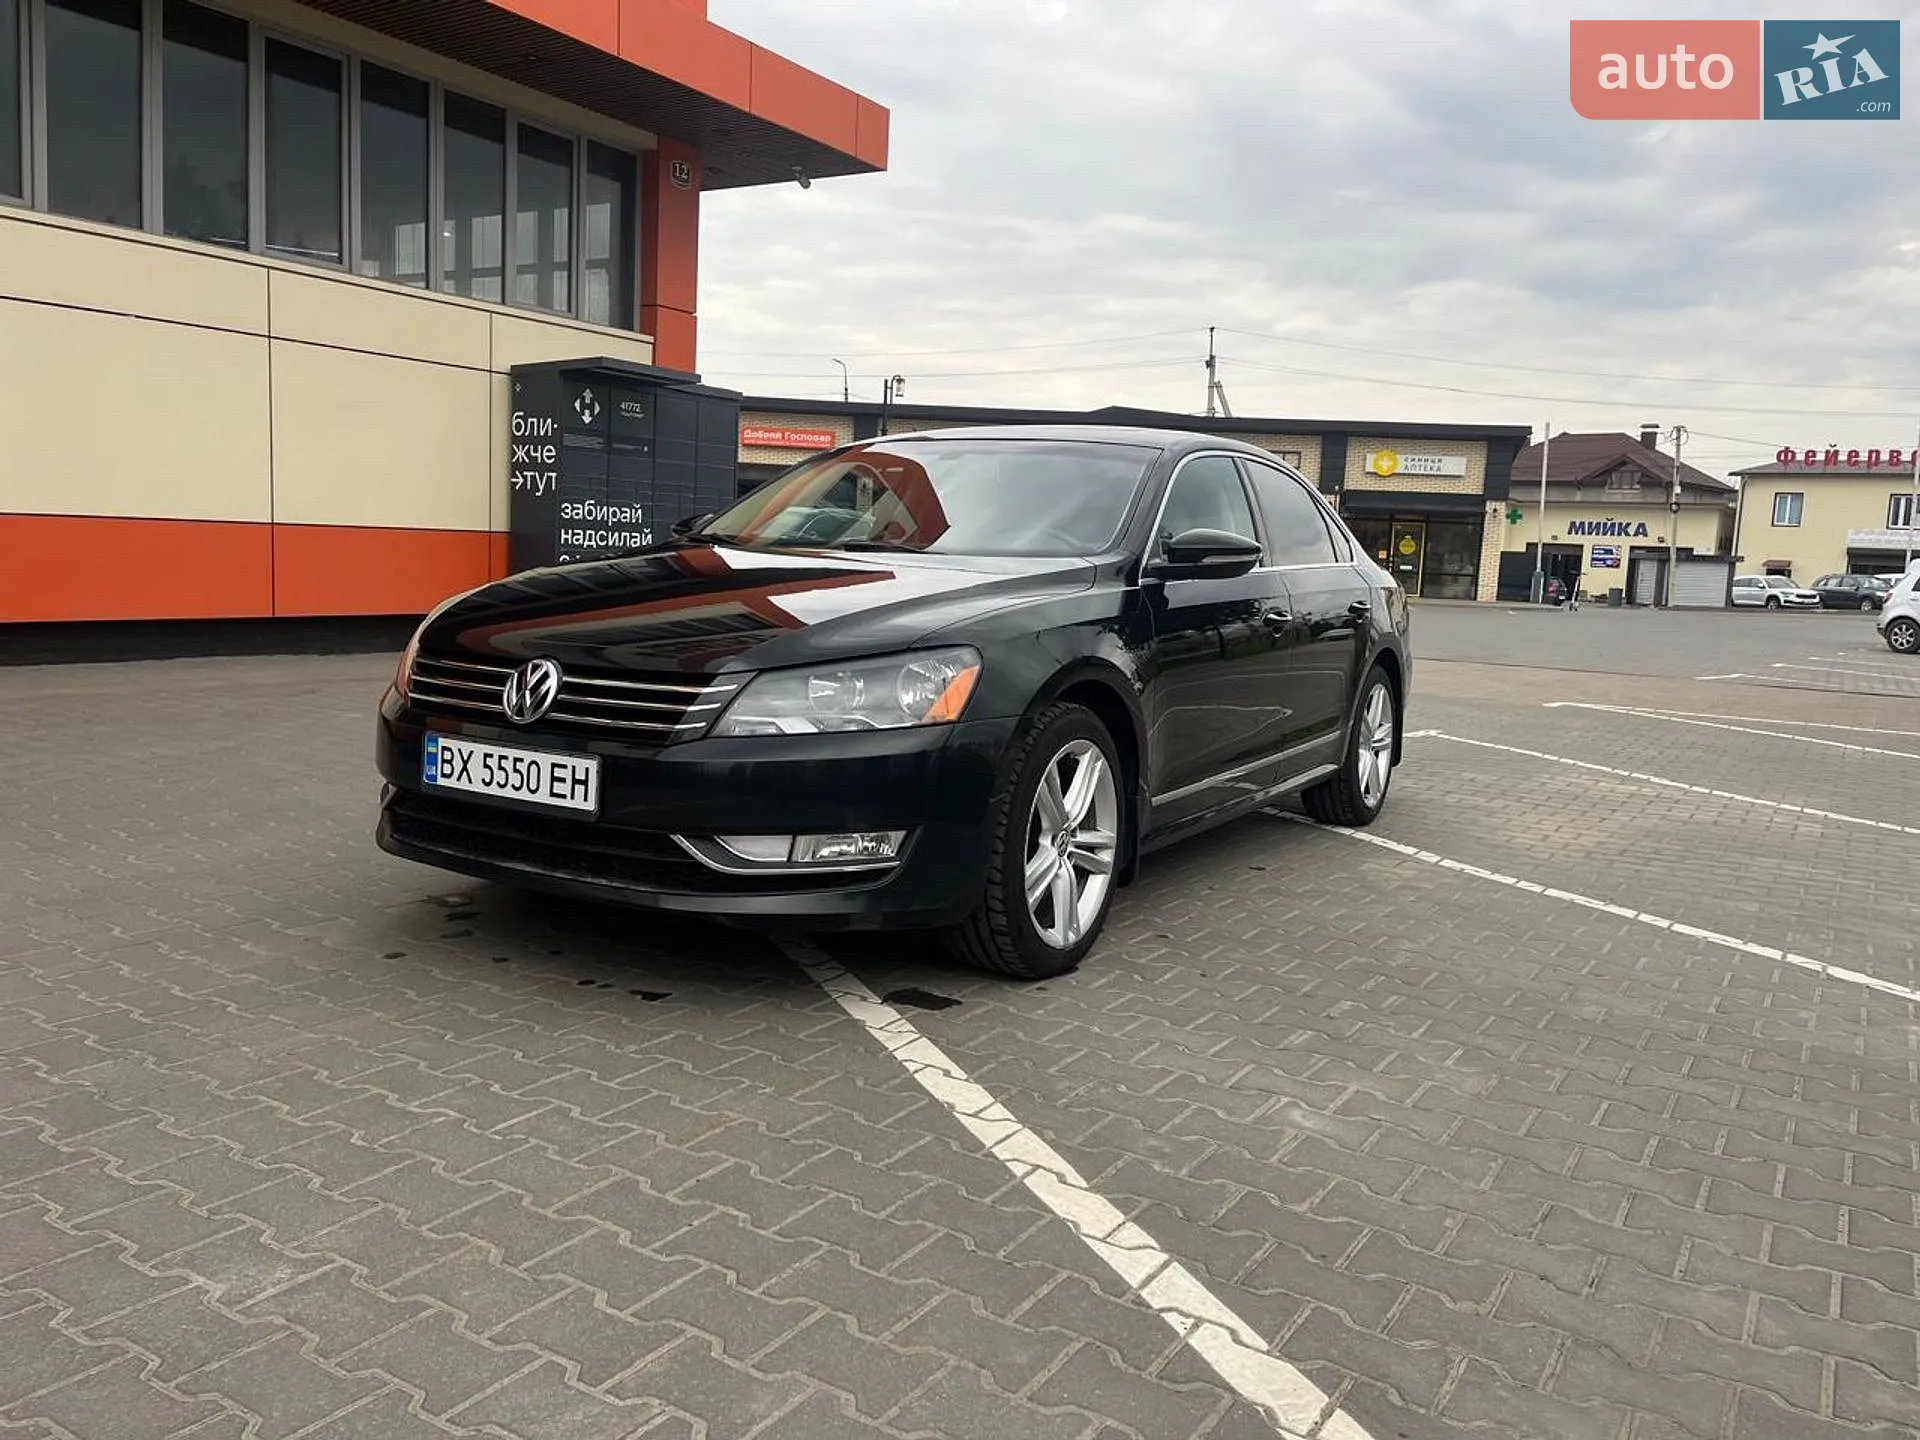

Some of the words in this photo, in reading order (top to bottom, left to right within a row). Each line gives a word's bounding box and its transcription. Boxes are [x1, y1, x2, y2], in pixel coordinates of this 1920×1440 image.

[512, 444, 557, 464] жче
[523, 471, 557, 497] тут
[561, 500, 642, 526] забирай
[561, 528, 652, 549] надсилай
[1567, 517, 1649, 538] МИЙКА
[440, 745, 475, 784] BX
[481, 752, 541, 795] 5550
[549, 762, 591, 802] EH
